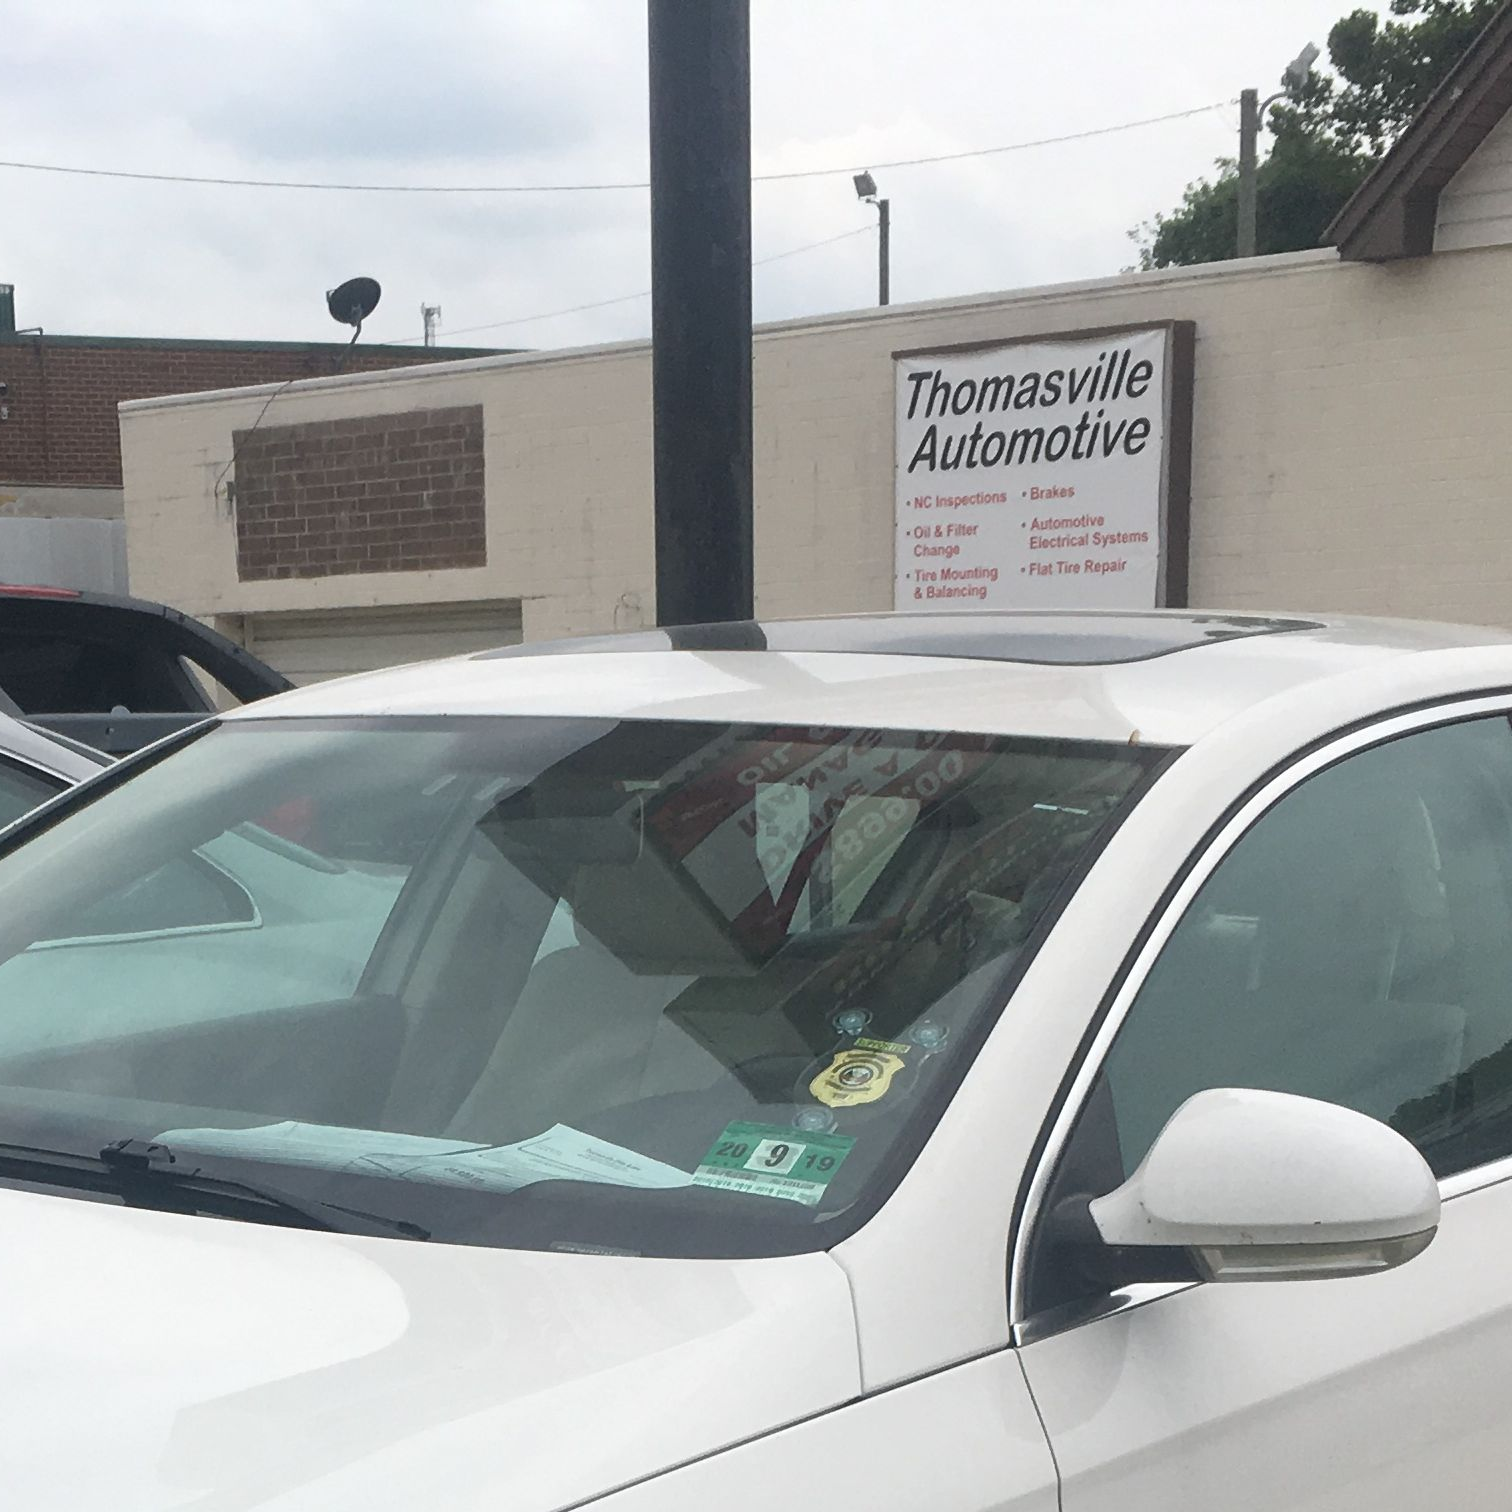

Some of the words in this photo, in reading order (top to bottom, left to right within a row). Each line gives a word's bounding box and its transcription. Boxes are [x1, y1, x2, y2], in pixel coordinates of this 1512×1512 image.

[907, 348, 1154, 420] Thomasville
[907, 408, 1151, 474] Automotive
[914, 496, 932, 510] NC
[936, 491, 1007, 509] Inspections
[1030, 485, 1075, 500] Brakes
[914, 525, 931, 539] Oil
[934, 525, 943, 538] &
[946, 523, 979, 537] Filter
[1031, 514, 1105, 531] Automotive
[1029, 533, 1089, 549] Electrical
[1092, 530, 1149, 548] Systems
[914, 543, 960, 559] Change
[915, 568, 937, 582] Tire
[941, 566, 999, 582] Mounting
[1029, 562, 1053, 576] Flat
[1056, 560, 1080, 575] Tire
[1084, 557, 1127, 575] Repair
[914, 587, 922, 600] &
[926, 584, 988, 600] Balancing
[716, 1141, 749, 1159] 20
[764, 1144, 790, 1168] 9
[805, 1154, 836, 1172] 19
